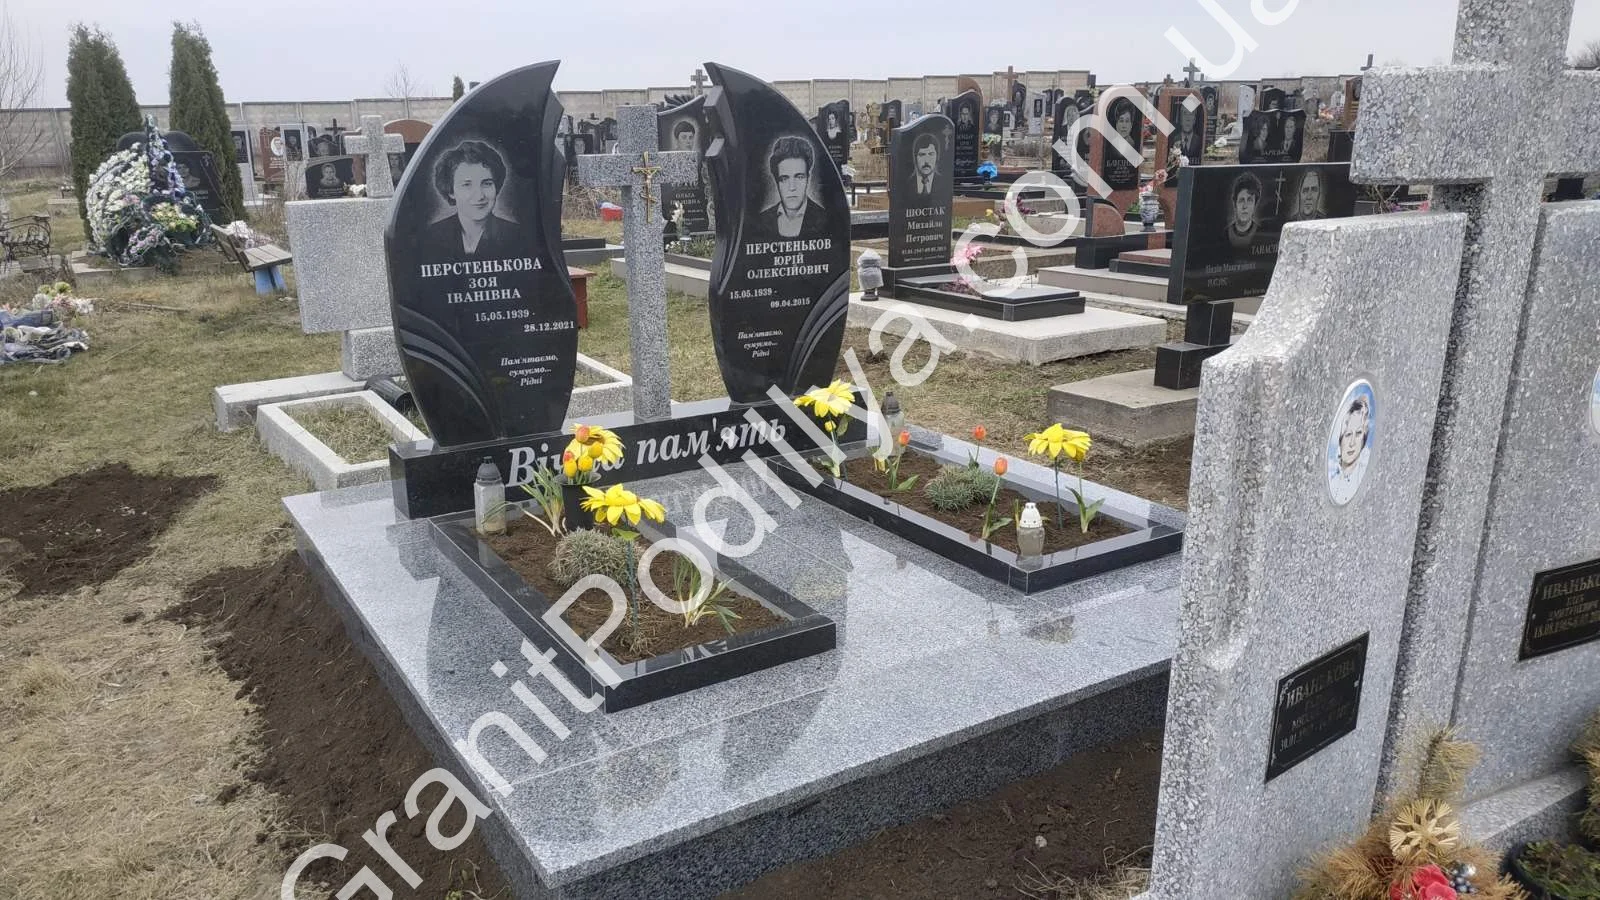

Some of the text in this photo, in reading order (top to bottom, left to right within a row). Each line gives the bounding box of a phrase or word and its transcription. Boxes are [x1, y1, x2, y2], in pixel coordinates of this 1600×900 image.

[906, 206, 945, 218] ШОСТАК
[746, 238, 832, 255] ПЕРСТЕНЬКОВ
[773, 253, 804, 266] ЮРІЙ
[420, 256, 542, 278] ПЕРСТЕНЬКОВА
[747, 263, 829, 280] ОЛЕКСІЙОВИЧ
[468, 276, 498, 289] ЗОЯ
[447, 288, 522, 304] ІВАНІВНА
[730, 287, 773, 300] 15.05.1939
[523, 320, 575, 333] 28.12.2021
[520, 376, 543, 387] Рідні
[636, 417, 787, 466] пам'ять
